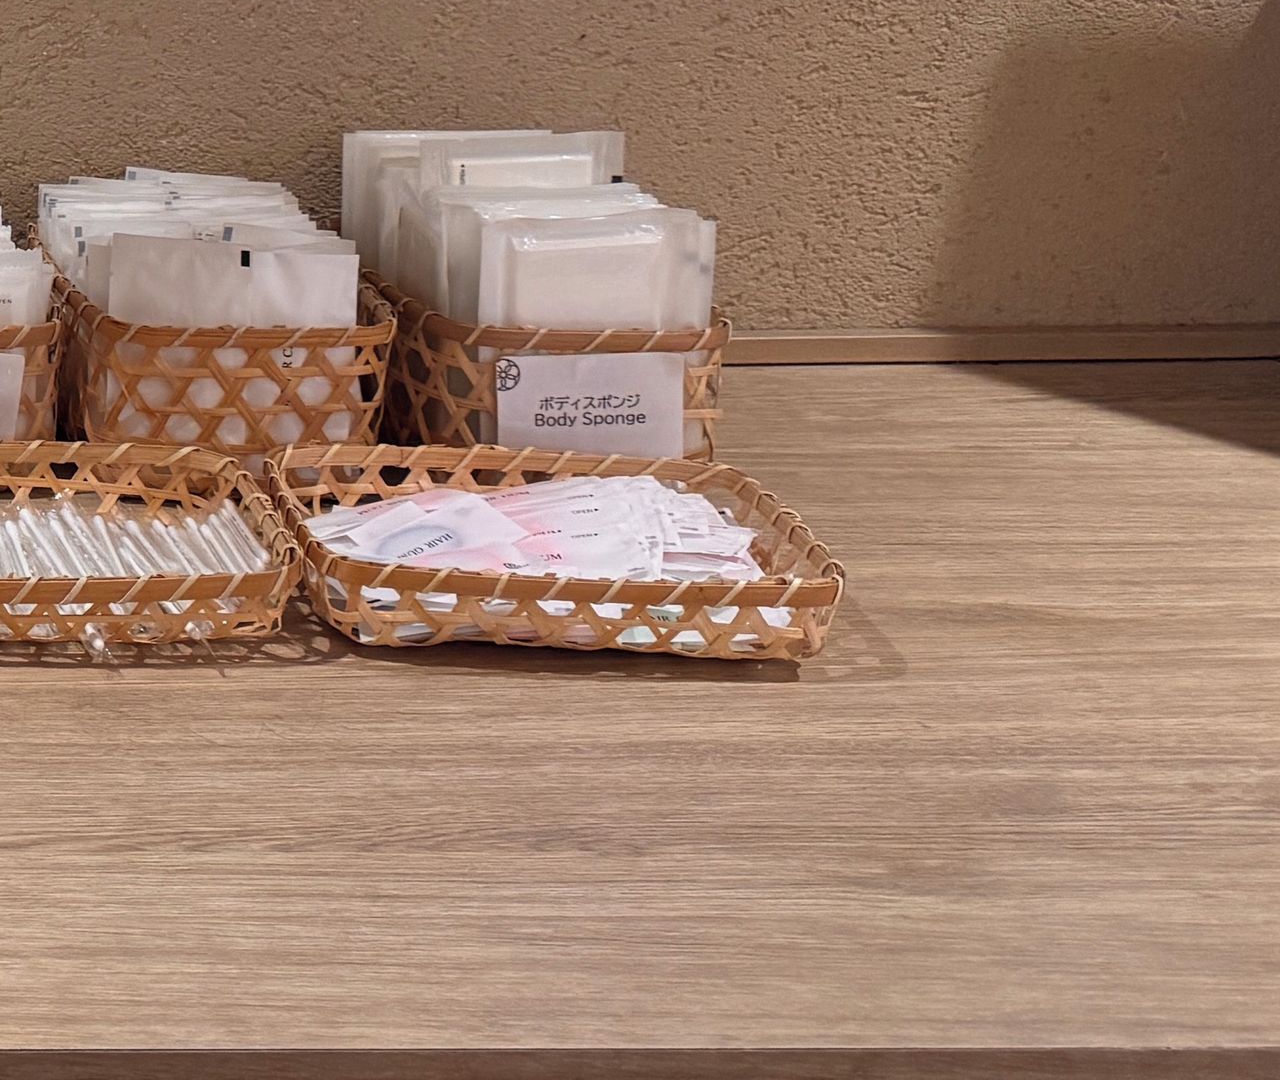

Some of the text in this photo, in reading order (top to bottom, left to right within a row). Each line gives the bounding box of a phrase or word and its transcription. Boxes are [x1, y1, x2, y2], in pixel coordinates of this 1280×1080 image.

[538, 393, 642, 413] ボディスポンジ
[534, 409, 647, 429] Body Sponge
